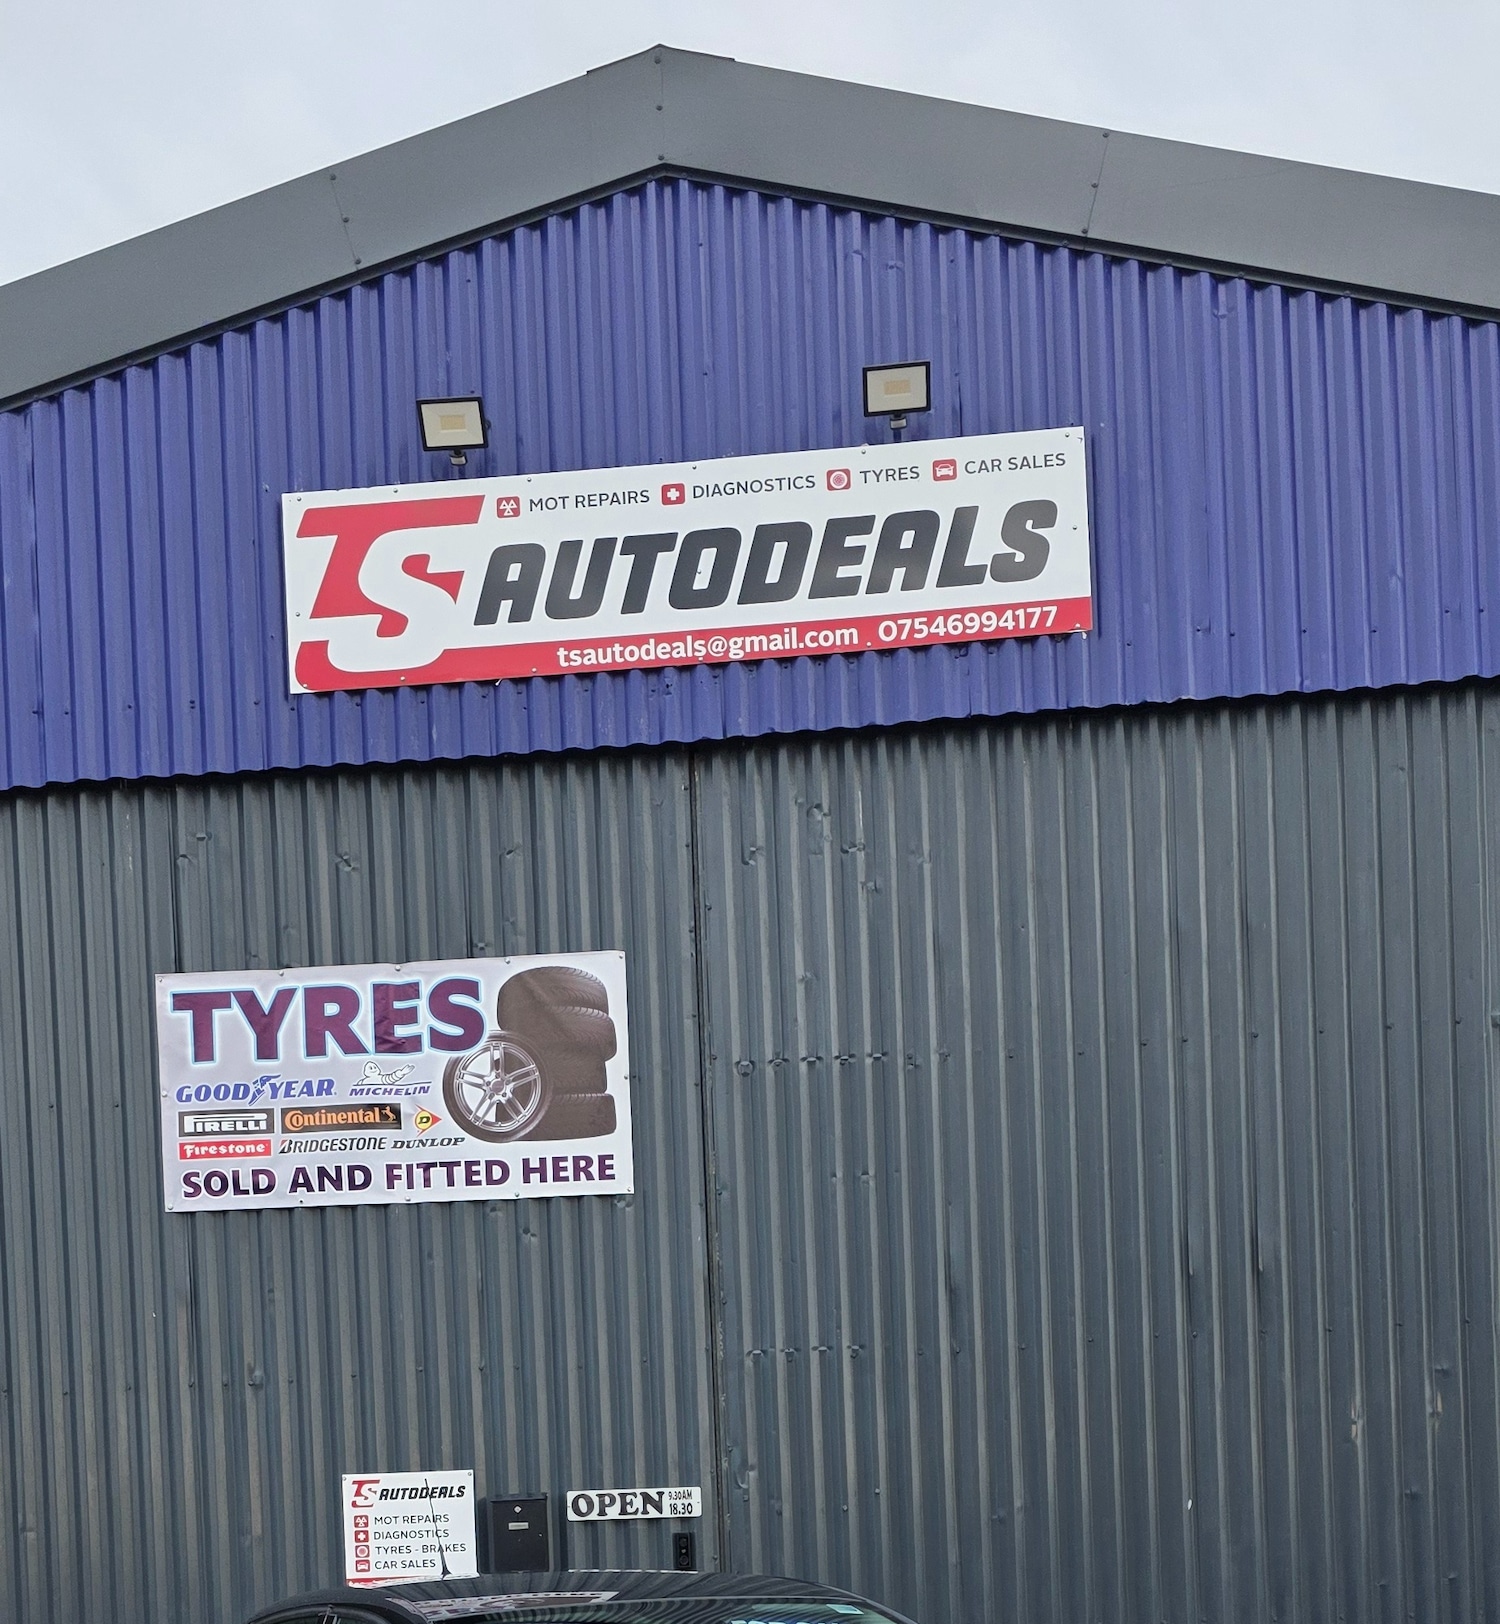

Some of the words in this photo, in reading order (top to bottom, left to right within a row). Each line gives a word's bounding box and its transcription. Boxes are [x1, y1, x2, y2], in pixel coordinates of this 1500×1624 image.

[964, 458, 1002, 475] CAR
[1008, 453, 1066, 471] SALES
[860, 466, 920, 484] TYRES
[692, 475, 816, 499] DIAGNOSTICS
[529, 496, 569, 512] MOT
[575, 489, 650, 509] REPAIRS
[296, 494, 486, 691] TS
[474, 499, 1058, 626] AUTODEALS
[557, 626, 858, 668] tsautodeals@gmail.com
[878, 606, 1058, 642] 07546994177
[172, 978, 485, 1063] TYRES
[349, 1085, 431, 1097] MICHELIN
[183, 1112, 268, 1134] PIRELLI
[285, 1107, 380, 1132] Continental
[184, 1142, 266, 1159] Firestone
[279, 1137, 387, 1155] BRIDGESTONE
[391, 1137, 465, 1150] DUNLOP
[182, 1168, 276, 1198] SOLD
[289, 1164, 372, 1194] AND
[385, 1159, 511, 1190] FITTED
[522, 1154, 616, 1184] HERE
[379, 1485, 466, 1501] AUTODEALS
[571, 1491, 665, 1517] OPEN
[669, 1502, 693, 1515] 18.30
[374, 1515, 399, 1525] MOT
[402, 1513, 450, 1525] REPAIRS
[373, 1529, 450, 1540] DIAGNOSTICS
[375, 1545, 412, 1555] TYRES
[421, 1543, 467, 1554] BRAKES
[374, 1560, 398, 1570] CAR
[400, 1559, 436, 1569] SALES
